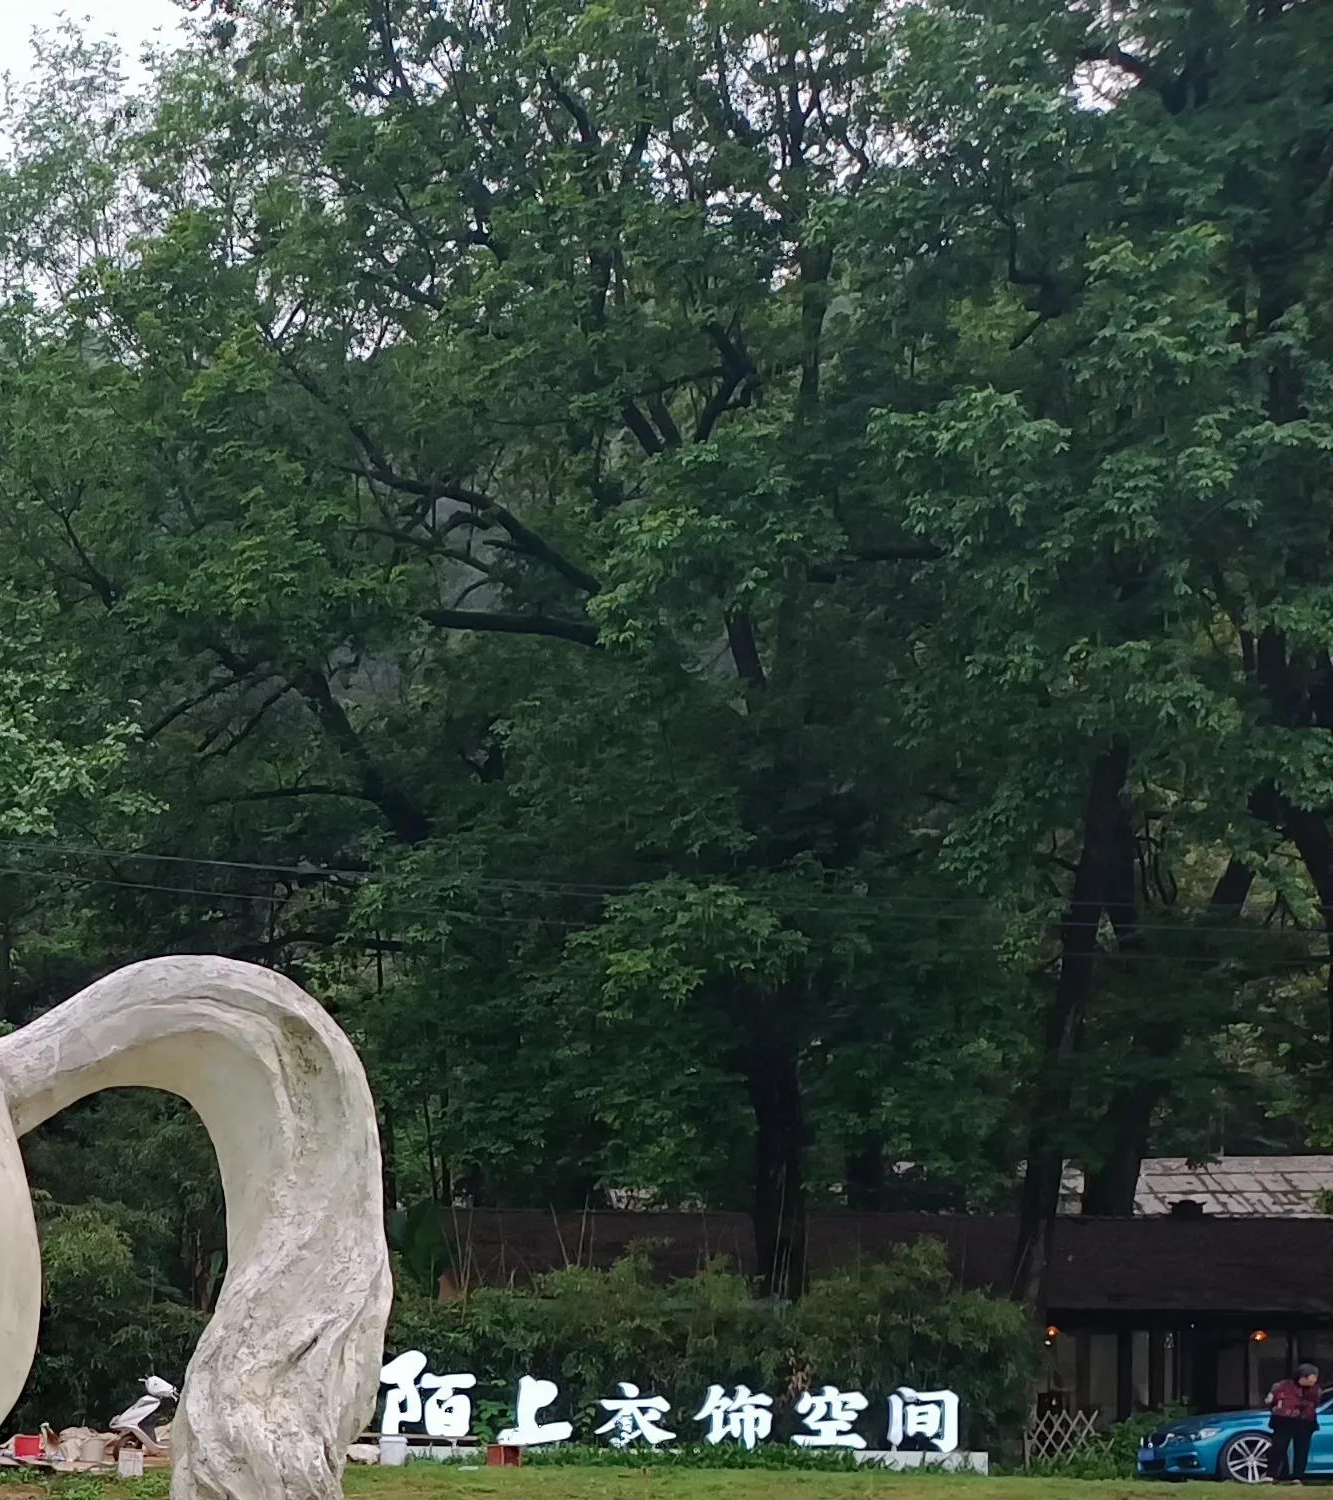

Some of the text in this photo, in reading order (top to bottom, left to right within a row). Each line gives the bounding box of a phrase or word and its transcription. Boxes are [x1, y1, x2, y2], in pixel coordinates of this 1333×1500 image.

[380, 1350, 959, 1453] 陌上衣饰空间
